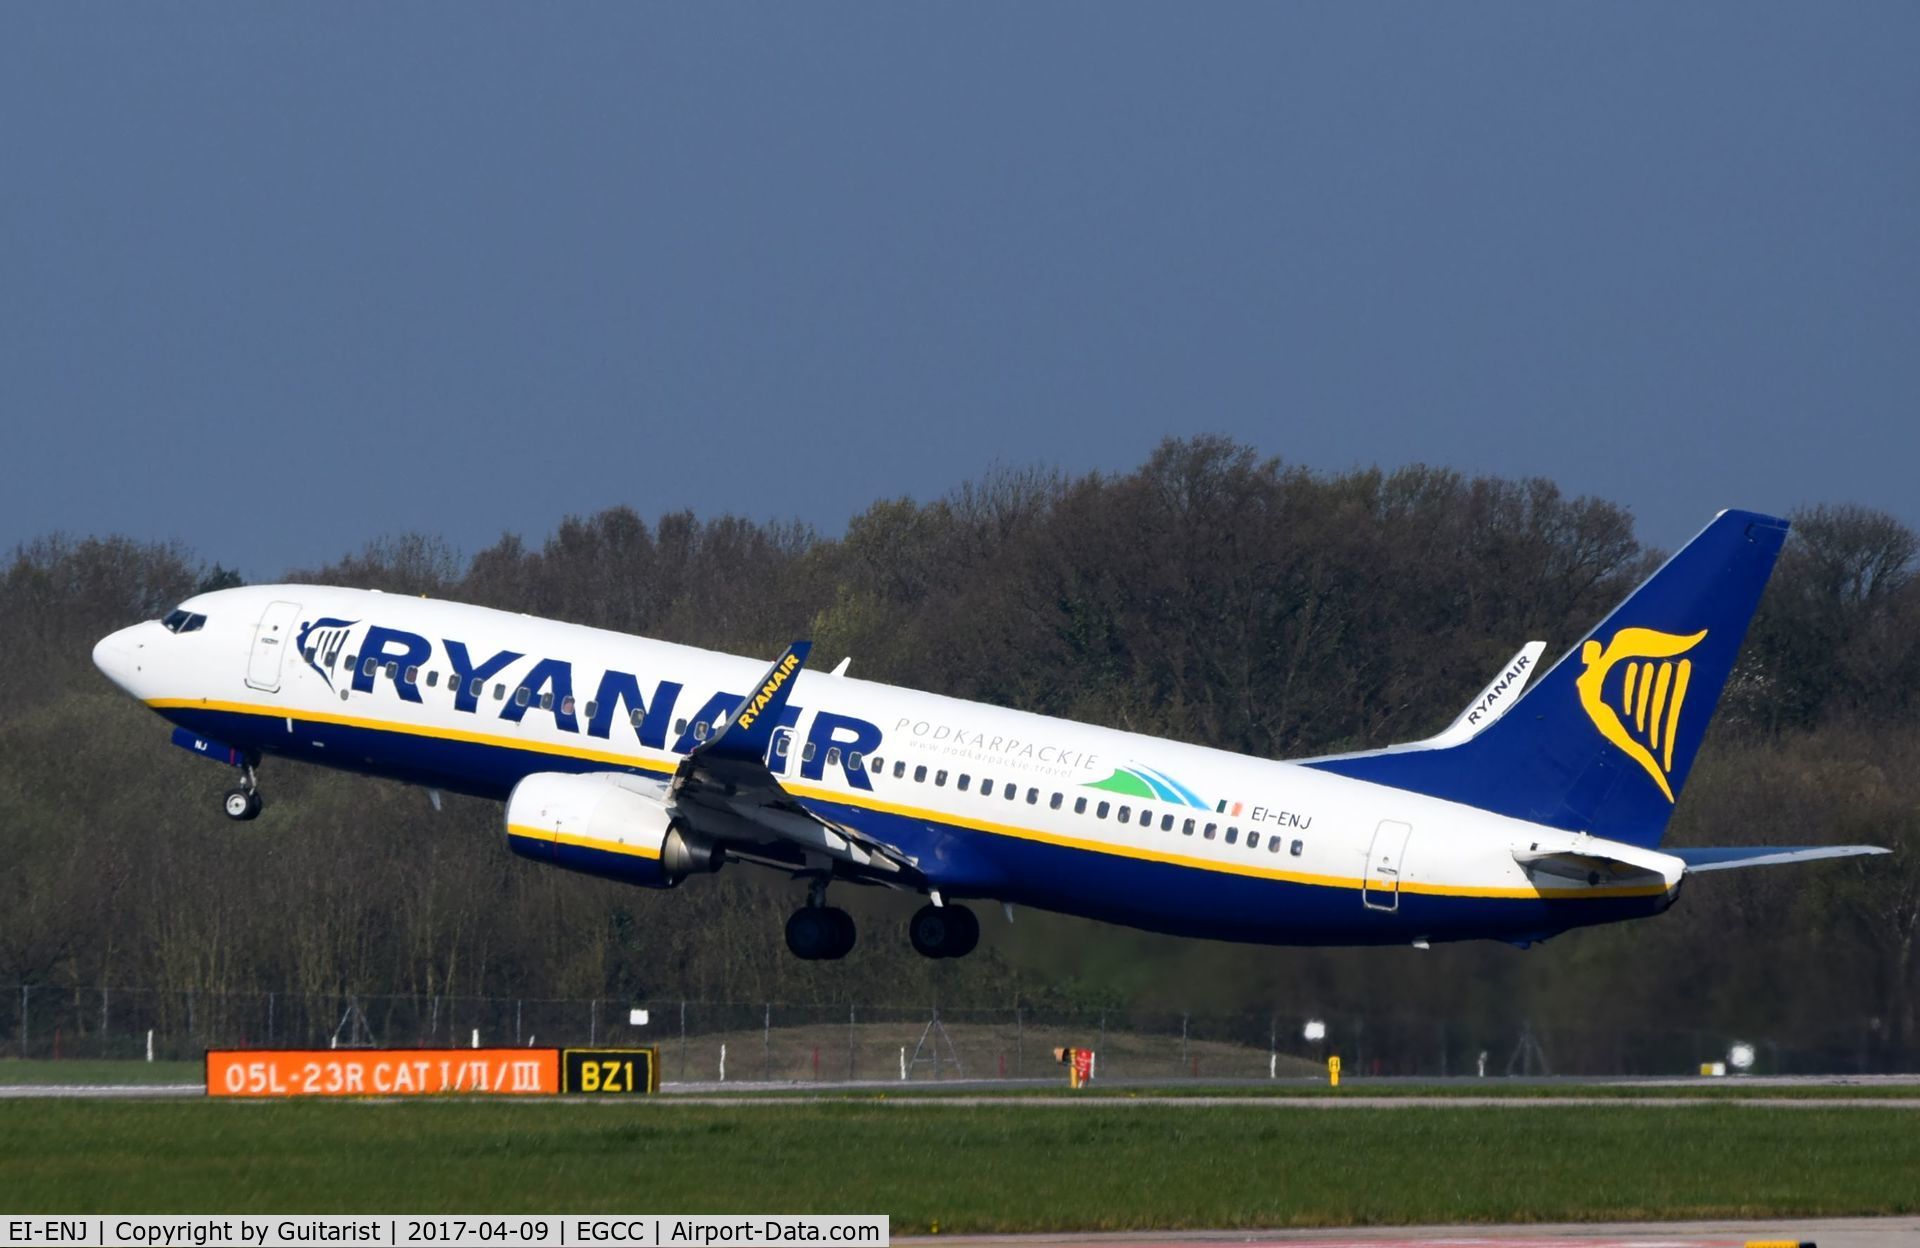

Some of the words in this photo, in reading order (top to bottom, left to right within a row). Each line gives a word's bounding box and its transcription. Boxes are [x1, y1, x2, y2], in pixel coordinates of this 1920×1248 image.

[737, 653, 800, 730] RYANAIR
[1467, 655, 1531, 725] RYANAIR
[194, 739, 208, 751] NJ
[894, 718, 1099, 770] PODKARPACKIE
[908, 740, 1073, 778] www.podkarpackie.travel
[1251, 806, 1313, 830] EI-ENJ
[373, 1061, 431, 1092] CAT
[580, 1061, 633, 1092] BZ1
